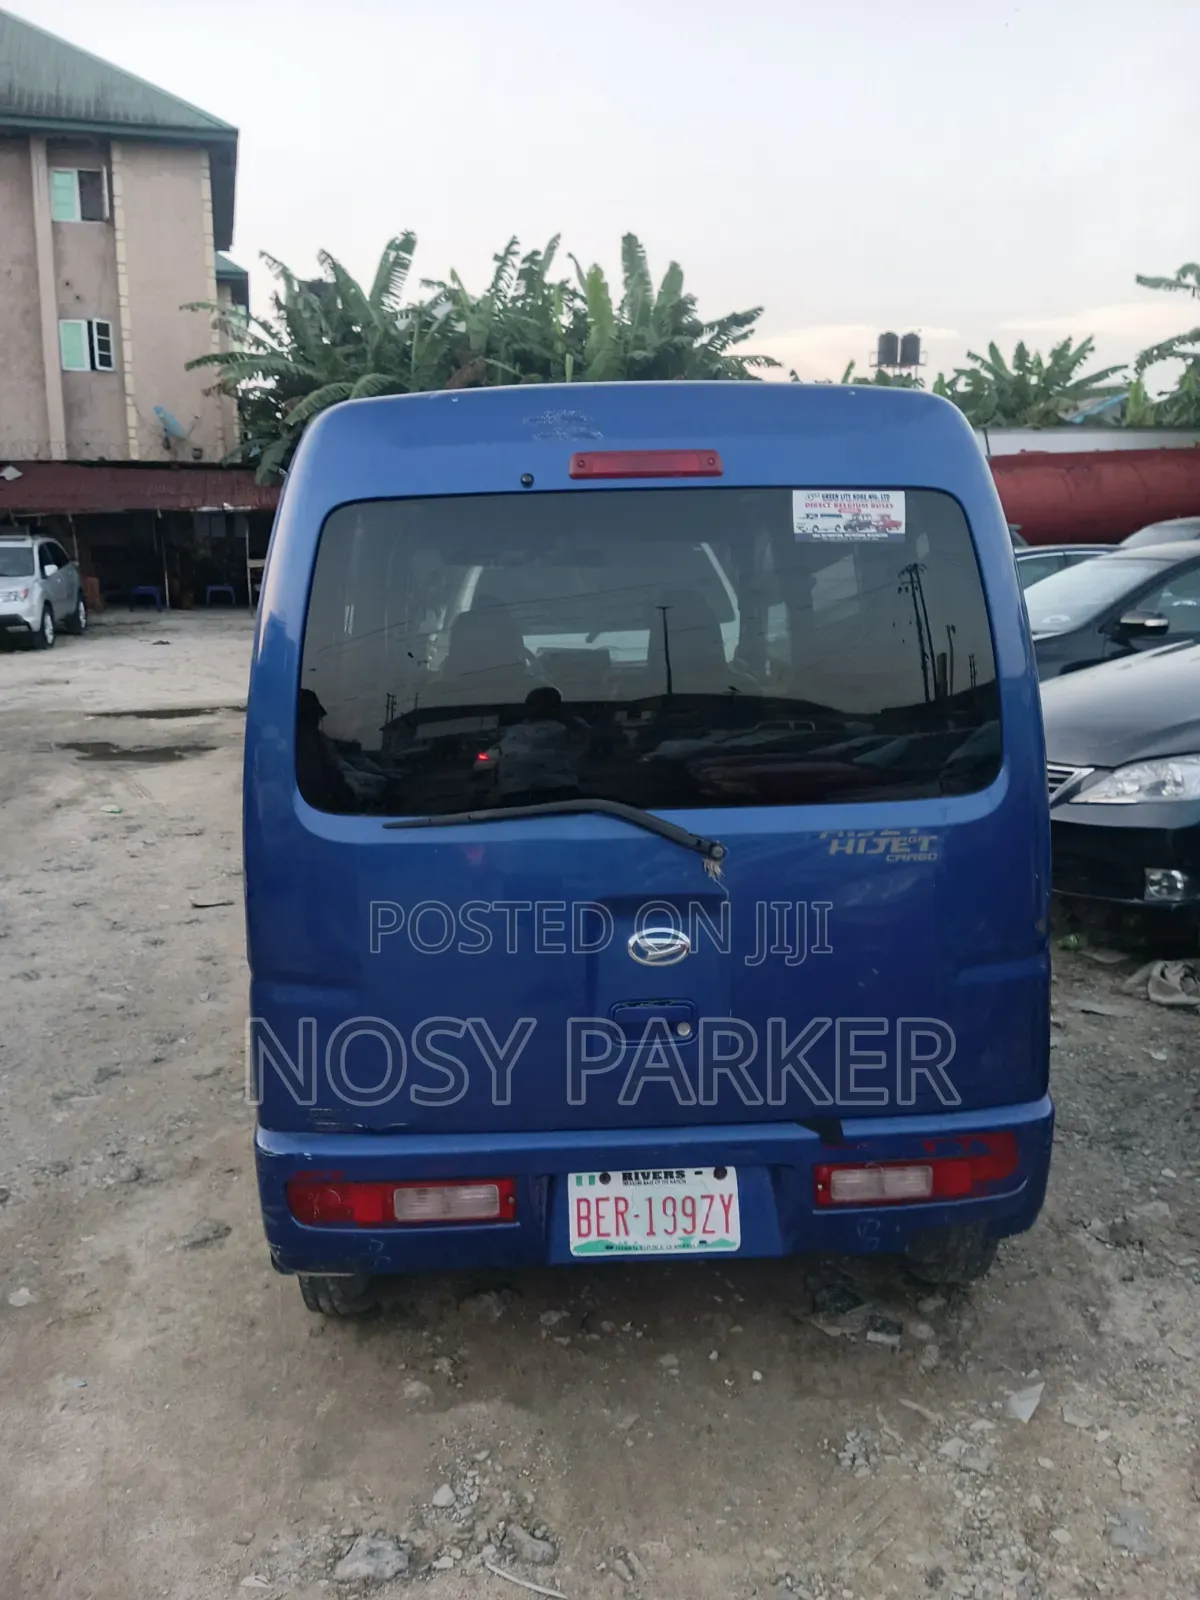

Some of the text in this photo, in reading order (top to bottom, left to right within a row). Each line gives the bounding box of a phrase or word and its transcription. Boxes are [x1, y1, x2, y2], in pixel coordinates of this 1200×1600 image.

[828, 835, 938, 856] HIJET
[621, 1170, 686, 1181] RIVERS
[575, 1193, 734, 1239] BER-199ZY
